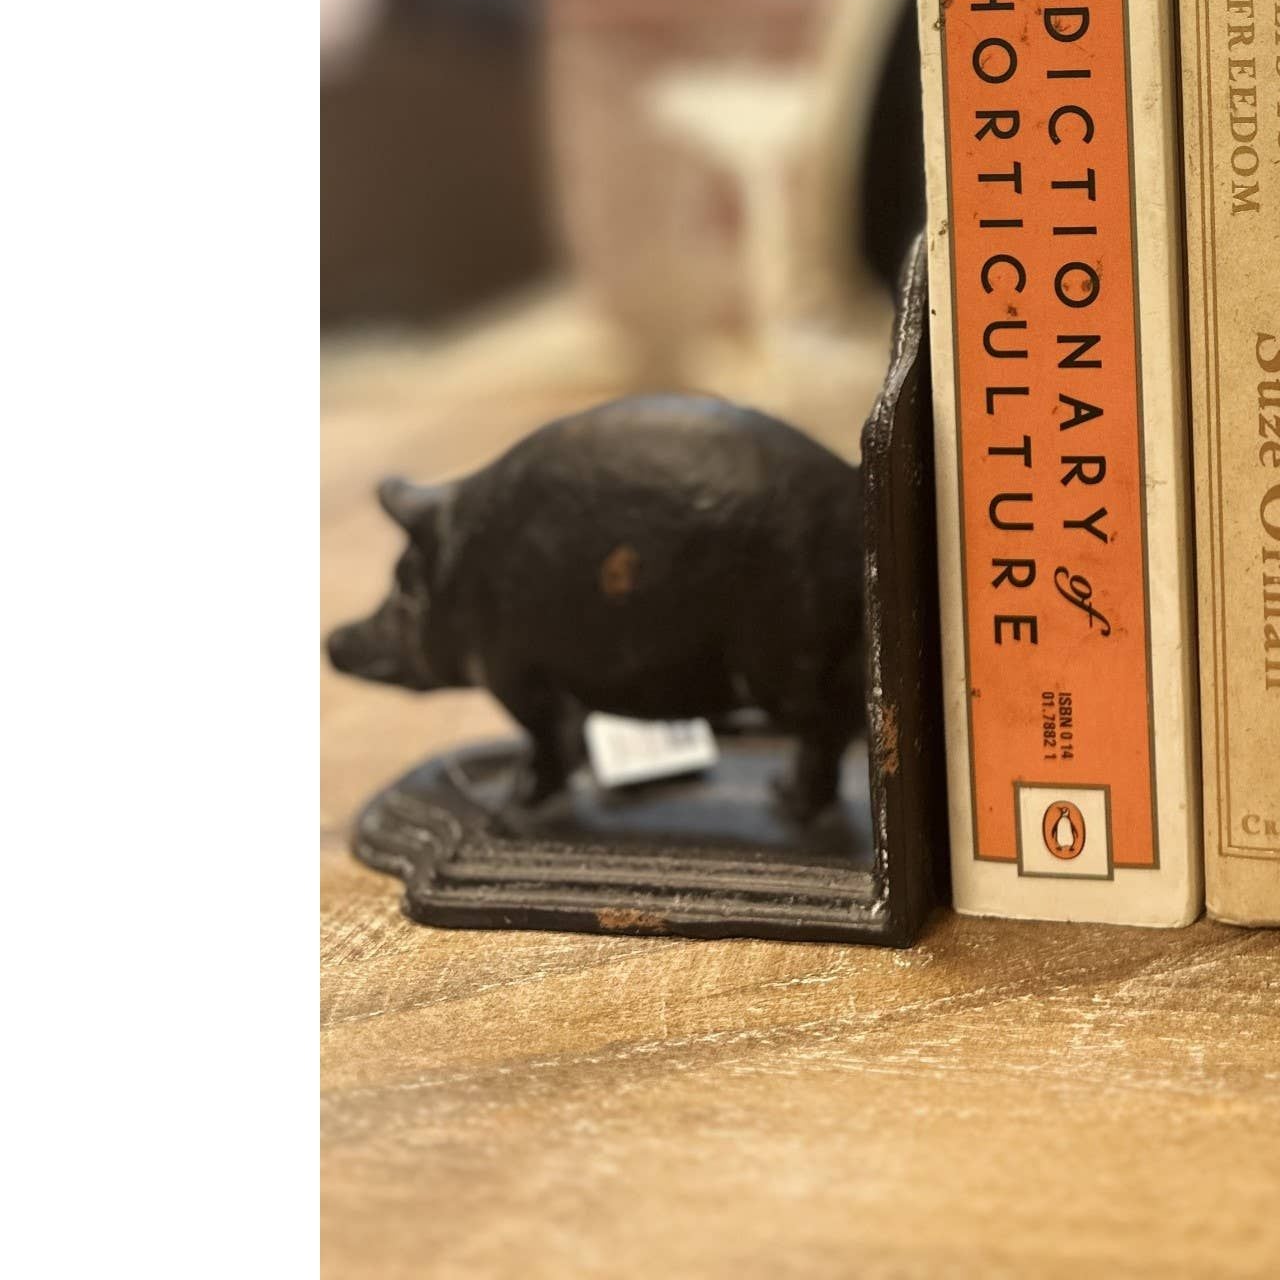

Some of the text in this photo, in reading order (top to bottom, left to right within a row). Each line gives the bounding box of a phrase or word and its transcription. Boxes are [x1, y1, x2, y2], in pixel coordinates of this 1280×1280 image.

[1044, 6, 1112, 637] DICTIONARY of
[1058, 692, 1074, 759] ISBN 0 14
